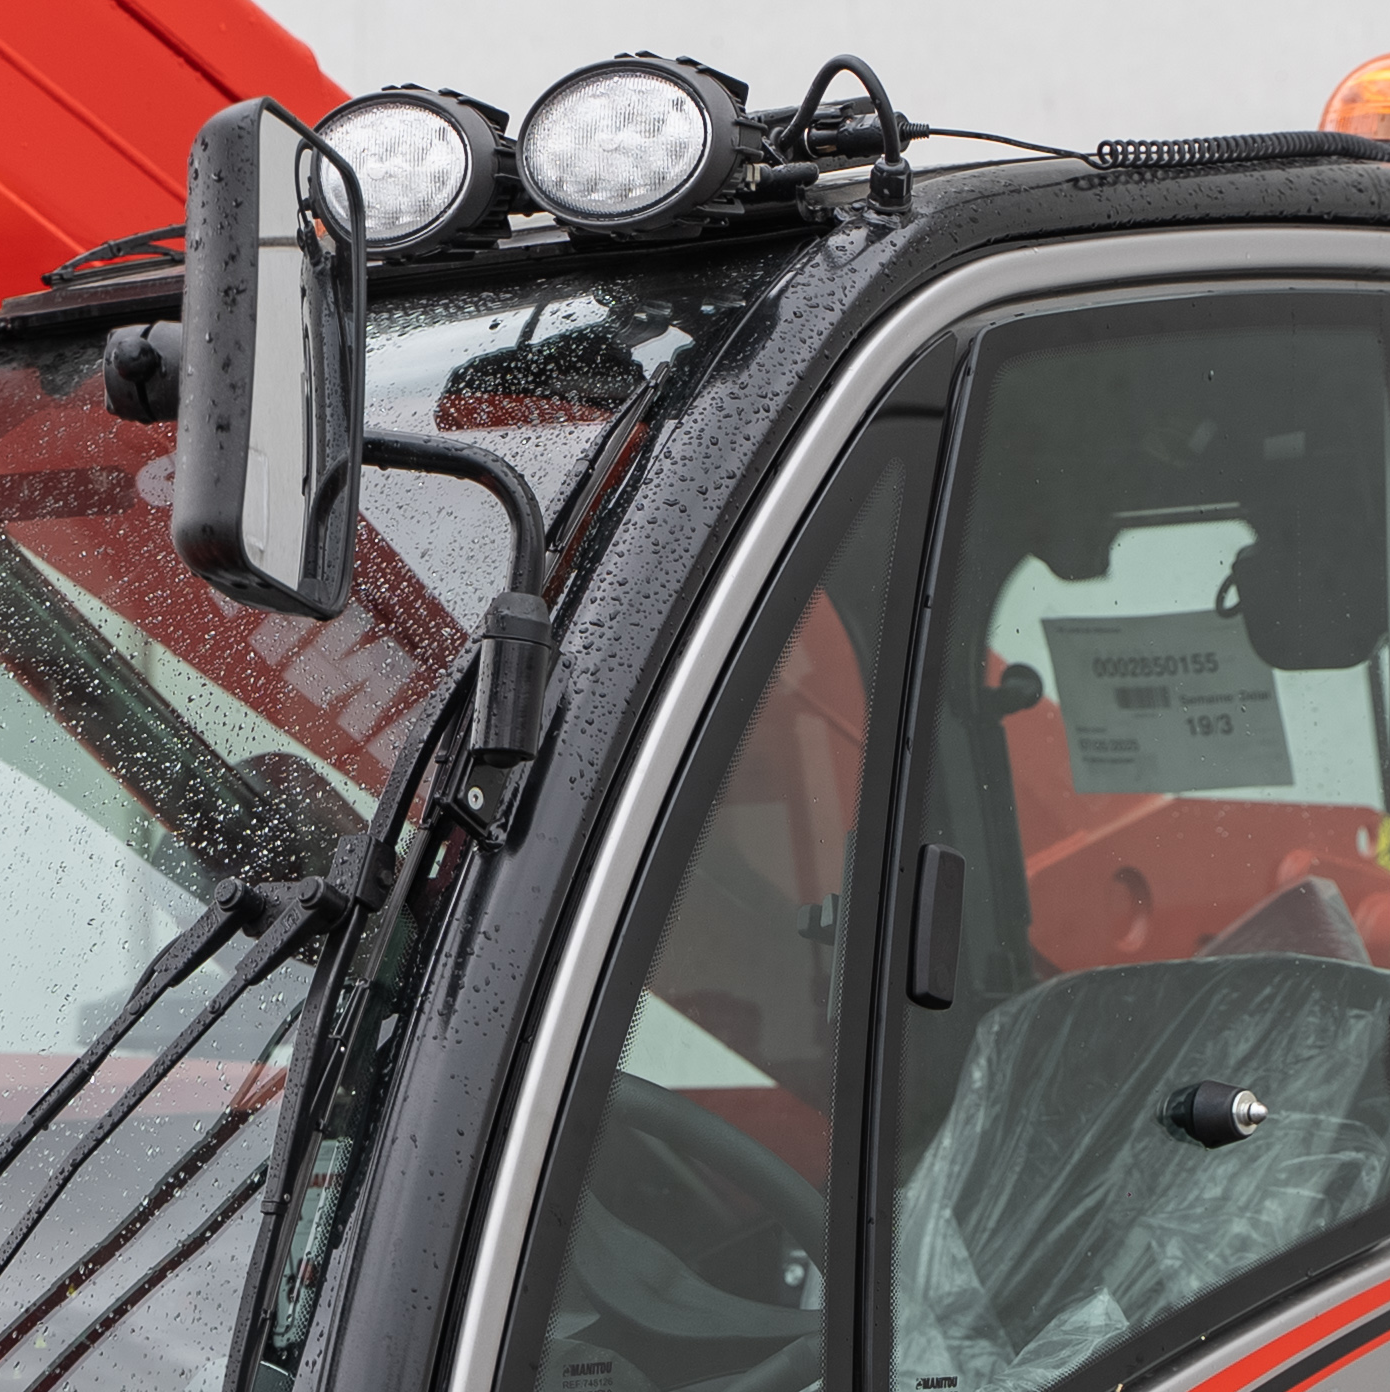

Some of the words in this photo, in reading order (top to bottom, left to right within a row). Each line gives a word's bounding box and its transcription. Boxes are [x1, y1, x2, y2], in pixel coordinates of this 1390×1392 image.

[1185, 713, 1235, 737] 19/3
[570, 1361, 613, 1376] MANITOU
[922, 1375, 958, 1389] MANITOU
